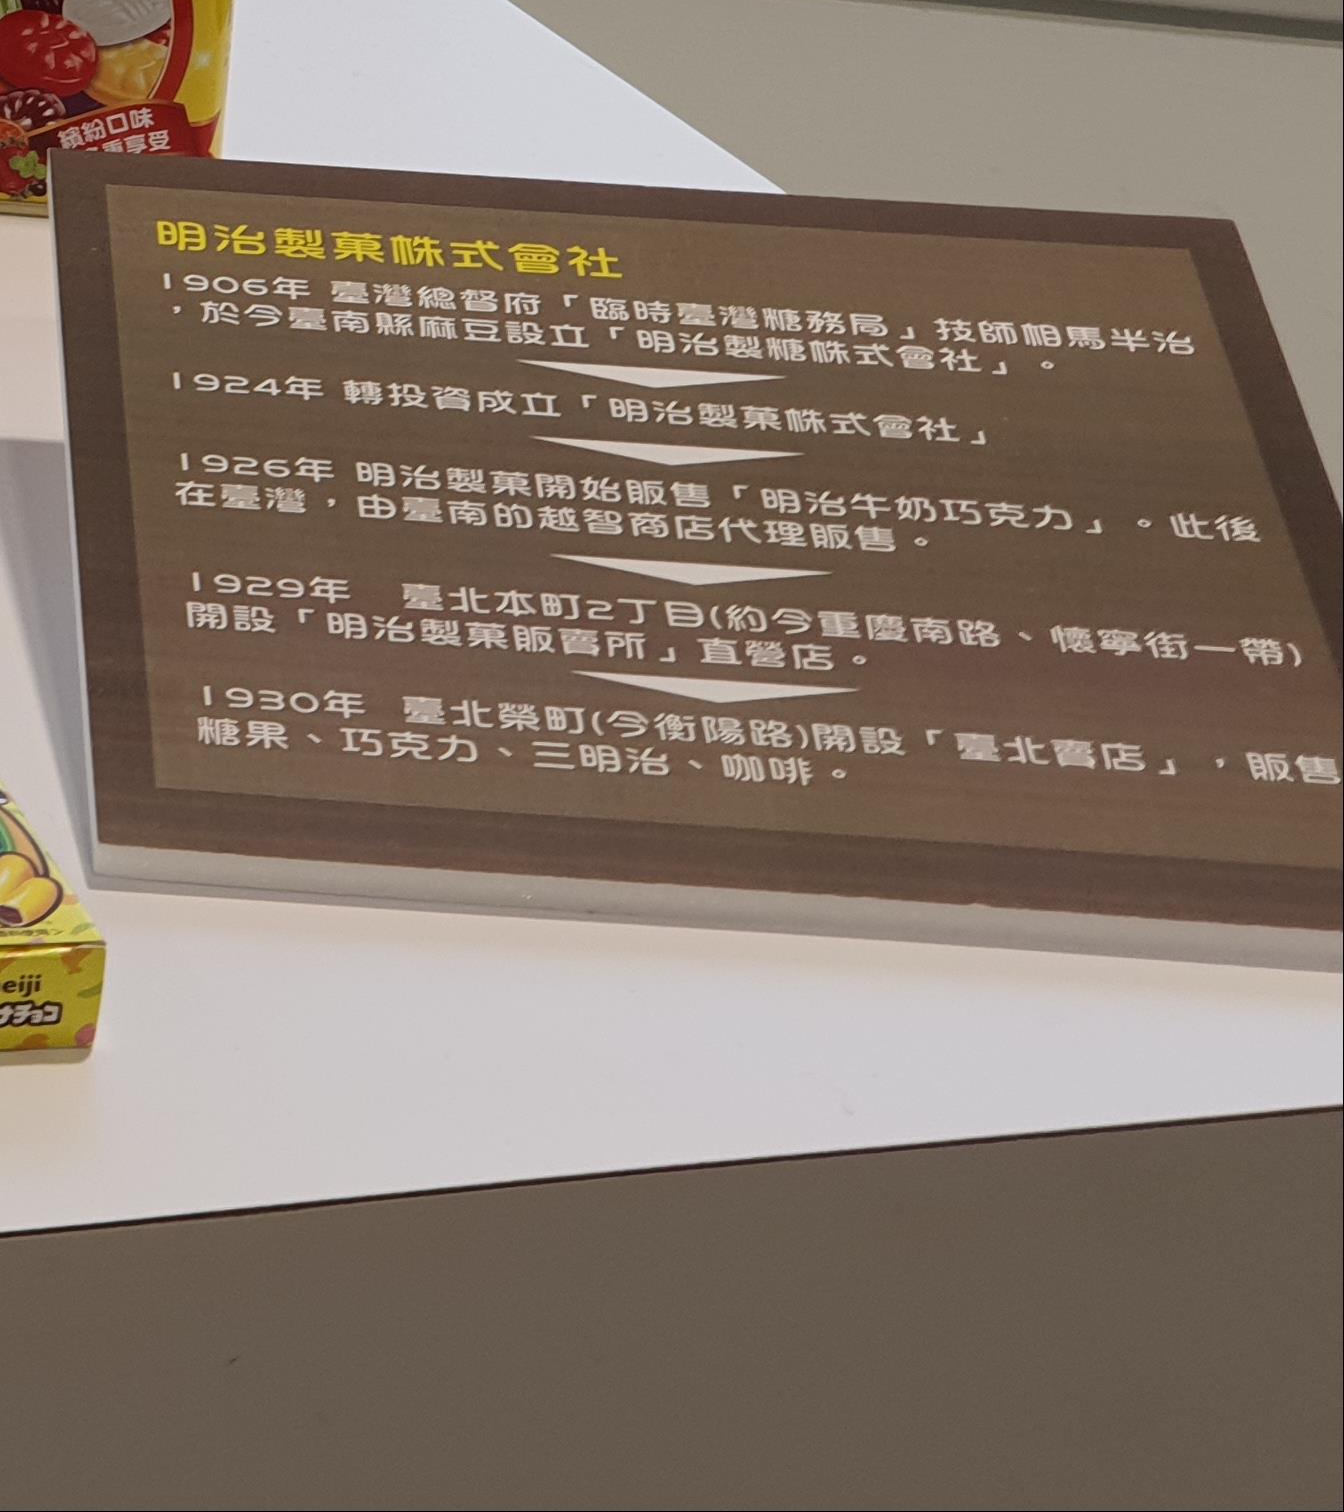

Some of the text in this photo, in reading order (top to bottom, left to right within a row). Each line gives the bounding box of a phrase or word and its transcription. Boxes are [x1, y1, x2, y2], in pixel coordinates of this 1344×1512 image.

[156, 220, 623, 279] 明治製菓株式會社
[162, 272, 312, 300] 1906年
[173, 371, 325, 401] 1924年
[179, 452, 335, 484] 1926年
[191, 571, 351, 606] 1929年
[202, 685, 366, 719] 1930年
